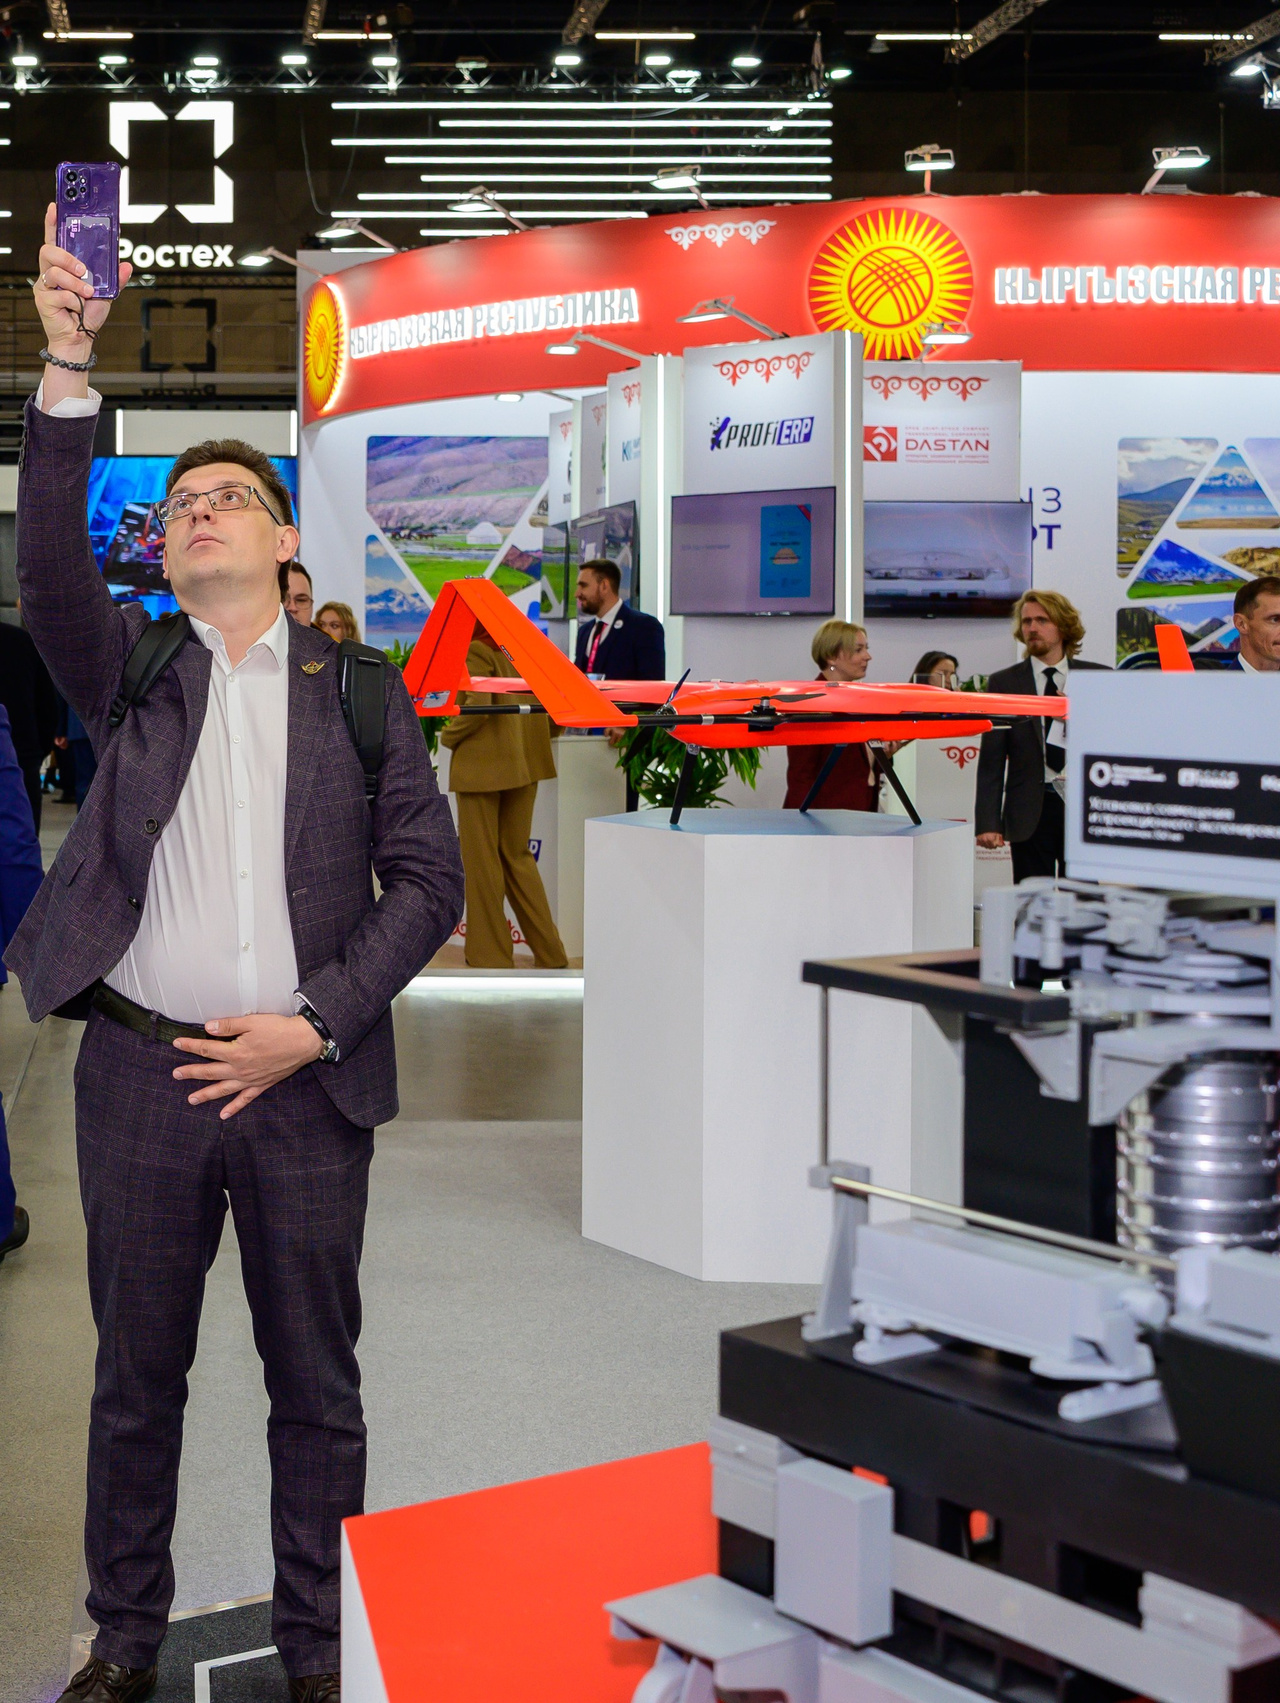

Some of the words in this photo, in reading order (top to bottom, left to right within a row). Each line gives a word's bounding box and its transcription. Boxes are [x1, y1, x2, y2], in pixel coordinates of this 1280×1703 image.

[120, 238, 234, 268] Ростех
[994, 265, 1239, 304] КЫРГЫЗСКАЯ
[1243, 266, 1280, 304] РЕ
[349, 306, 472, 360] КЫРГЫЗСКАЯ
[472, 287, 639, 338] РЕСПУБЛИКА
[905, 439, 989, 451] DASTAN
